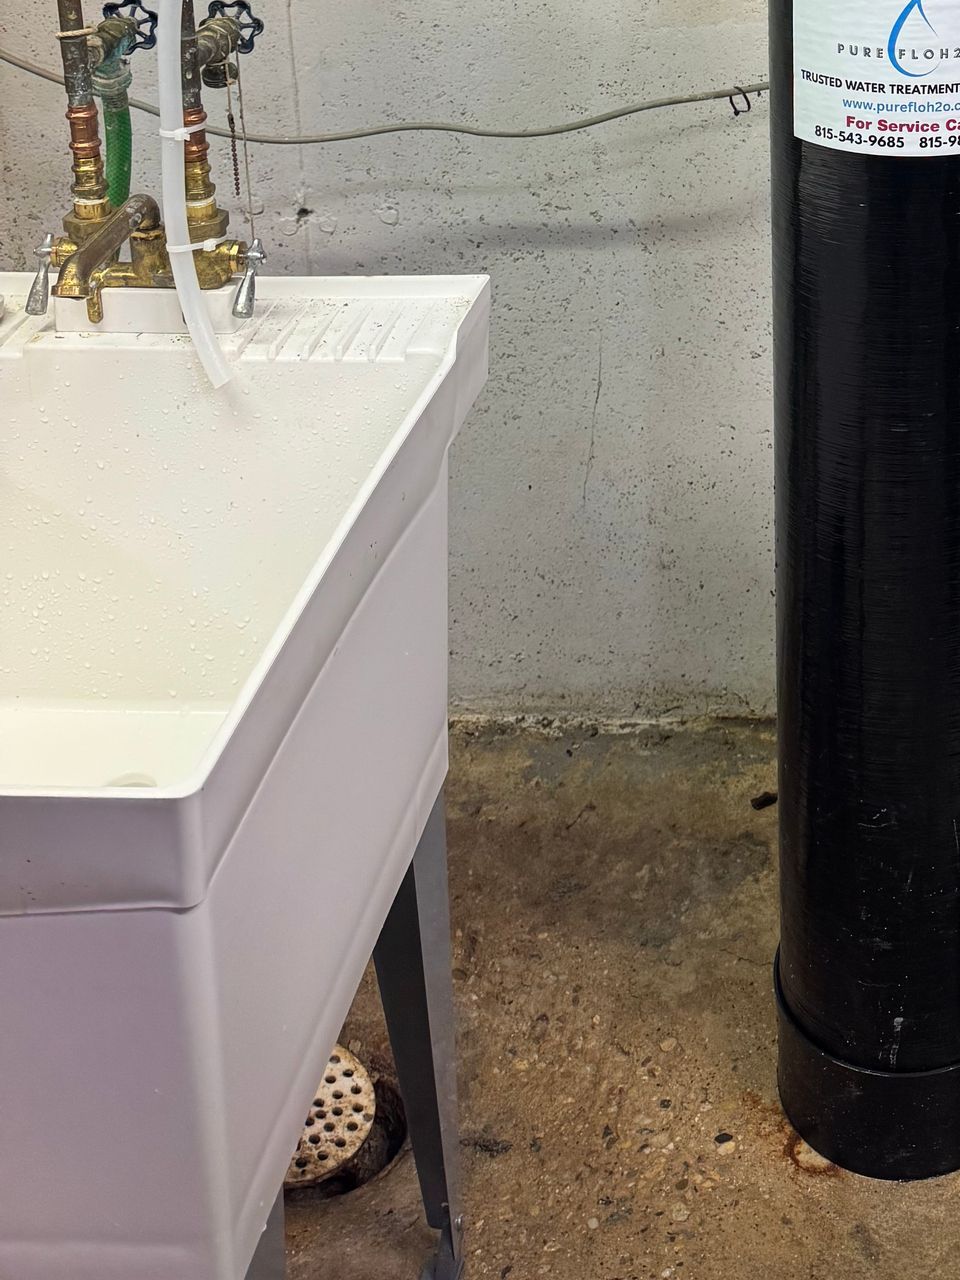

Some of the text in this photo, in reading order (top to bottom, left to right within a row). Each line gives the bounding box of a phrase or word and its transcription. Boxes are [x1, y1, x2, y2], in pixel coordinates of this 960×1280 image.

[837, 42, 885, 59] PURE
[801, 68, 843, 89] TRUSTED
[845, 79, 886, 94] WATER
[889, 83, 960, 95] TREATMENT
[846, 115, 873, 131] For
[877, 120, 940, 133] Service
[814, 125, 905, 149] 815-543-9685
